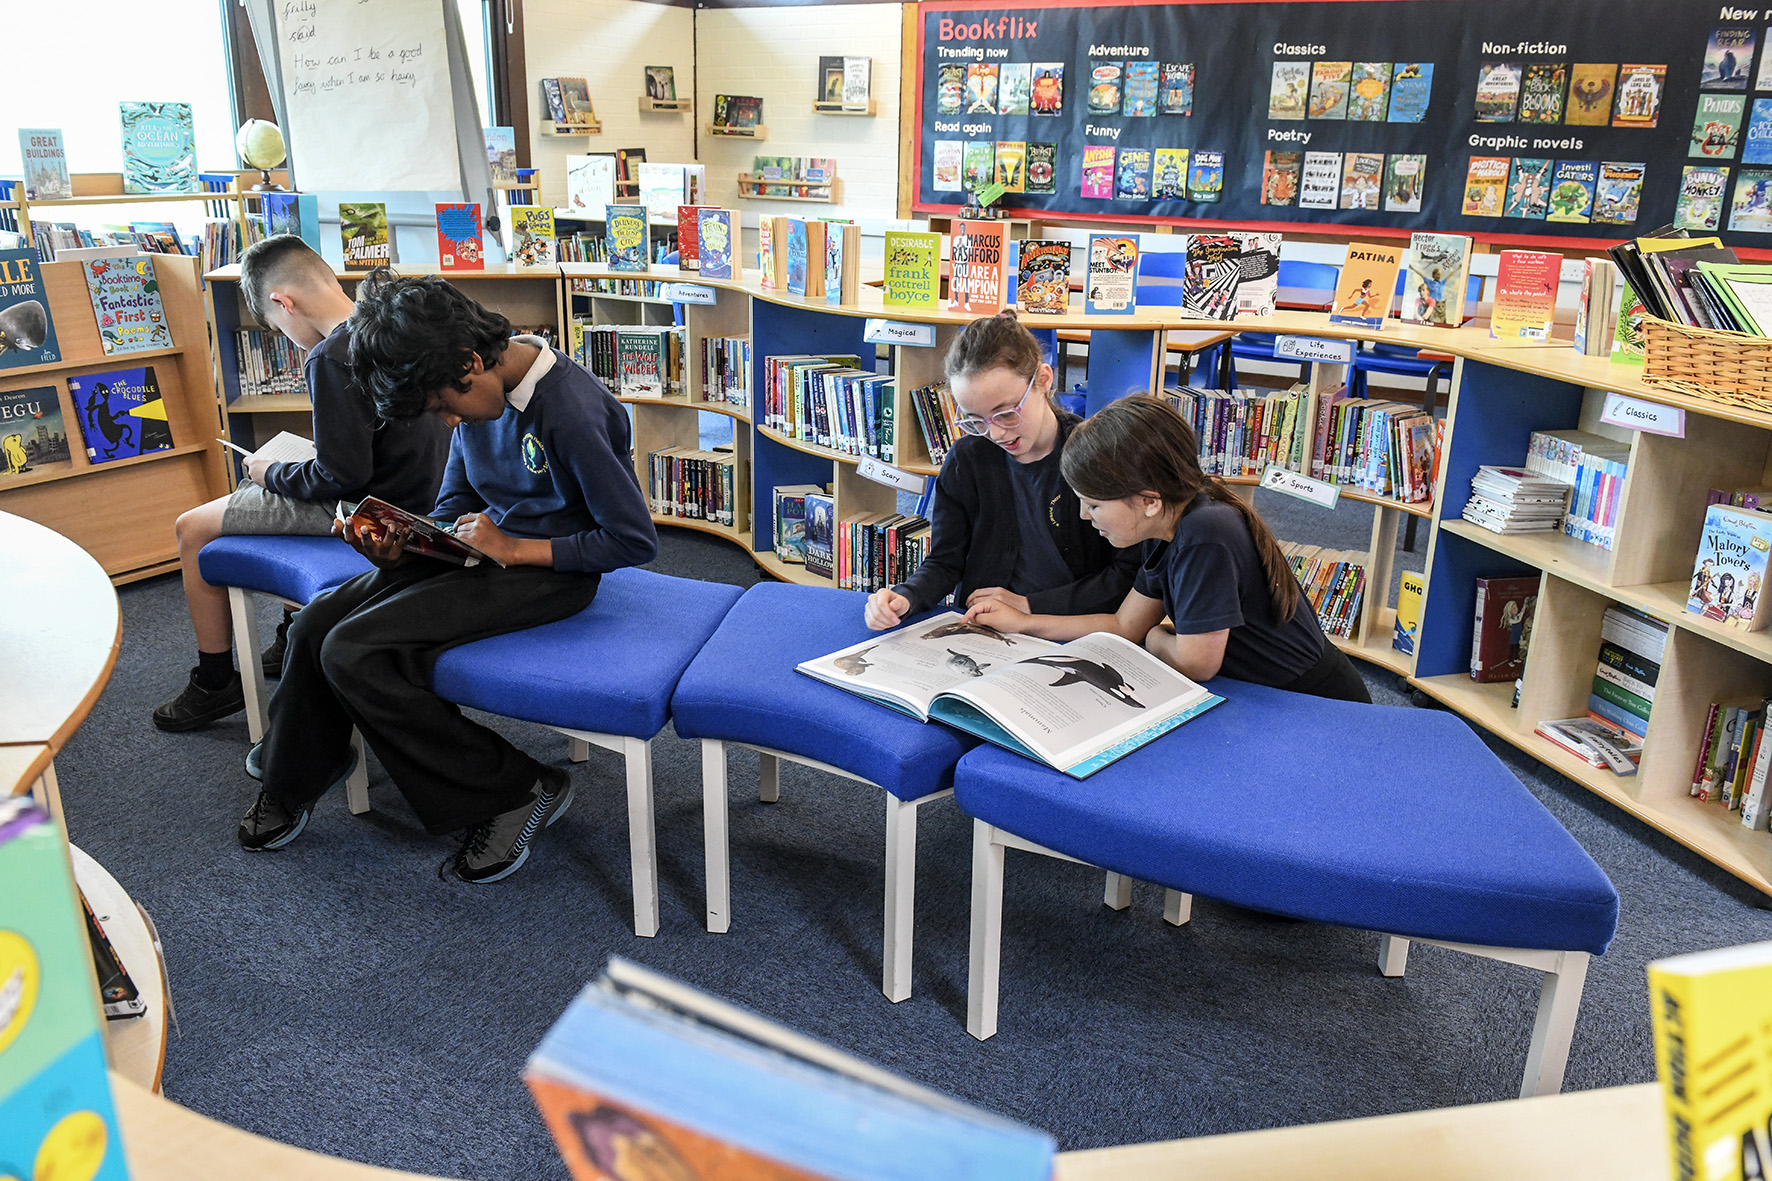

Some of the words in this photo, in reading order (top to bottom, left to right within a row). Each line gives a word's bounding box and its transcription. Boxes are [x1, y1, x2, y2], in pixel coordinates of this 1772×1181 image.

[1720, 6, 1758, 20] New
[939, 16, 1038, 41] Bookflix
[327, 56, 347, 65] can
[399, 43, 423, 63] good
[937, 46, 984, 61] Trending
[986, 48, 1009, 58] now
[1088, 44, 1150, 56] Adventure
[1273, 42, 1326, 55] Classics
[1481, 41, 1567, 54] Non-fiction
[1702, 97, 1742, 113] PANDAS
[934, 121, 961, 132] Read
[962, 122, 992, 137] again
[1085, 125, 1121, 140] Funny
[30, 136, 57, 148] GREAT
[136, 131, 178, 142] OCEAN
[1268, 129, 1312, 144] Poetry
[1468, 134, 1528, 150] Graphic
[1533, 137, 1584, 149] novels
[26, 149, 64, 158] BUILDINGS
[1686, 172, 1725, 184] BUNNY
[348, 235, 365, 248] TOM
[890, 238, 934, 249] DESIRABLE
[966, 234, 1001, 248] MARCUS
[350, 244, 389, 259] PALMER
[952, 246, 1000, 264] RASHFORD
[1350, 251, 1395, 264] PATINA
[889, 267, 930, 279] frank
[952, 263, 969, 278] YOU
[970, 265, 990, 280] ARE
[991, 267, 999, 280] A
[101, 274, 141, 285] Booktime
[888, 280, 930, 290] cottrell
[951, 277, 999, 296] CHAMPION
[12, 283, 36, 297] MORE
[109, 284, 129, 295] Book
[678, 290, 709, 299] Adventures
[889, 289, 930, 304] boyce
[99, 294, 154, 312] Fantastic
[115, 309, 146, 325] First
[888, 328, 916, 337] Magical
[1309, 341, 1324, 349] Life
[1295, 349, 1342, 360] Experiences
[623, 362, 656, 375] WILDER
[111, 386, 155, 394] CROCODILE
[113, 379, 127, 388] THE
[4, 393, 26, 401] Deacon
[1626, 407, 1657, 421] Classics
[881, 469, 900, 483] Scary
[1290, 479, 1314, 493] Sports
[1707, 535, 1751, 557] Malory
[1713, 552, 1751, 571] Towers
